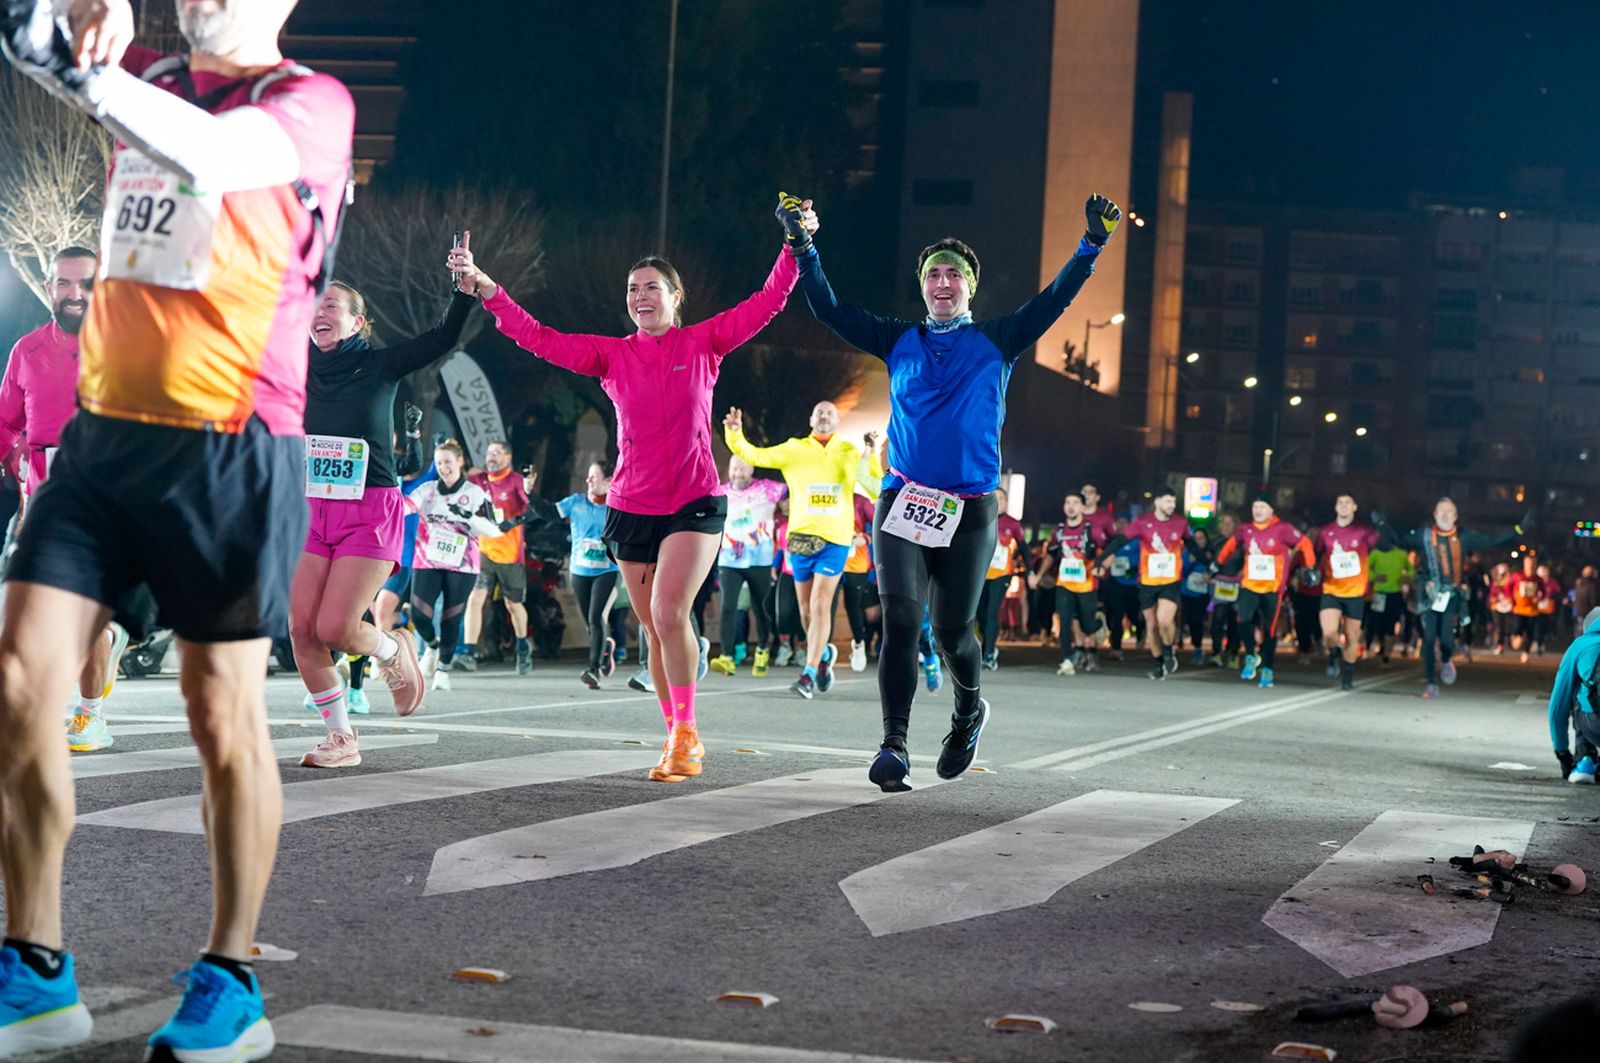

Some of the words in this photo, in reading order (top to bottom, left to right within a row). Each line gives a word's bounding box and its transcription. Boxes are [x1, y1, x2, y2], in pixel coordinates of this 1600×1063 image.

[116, 194, 176, 236] 692
[313, 457, 354, 479] 8253
[904, 494, 919, 503] SAN
[903, 502, 947, 531] 5322
[436, 541, 457, 554] 1361
